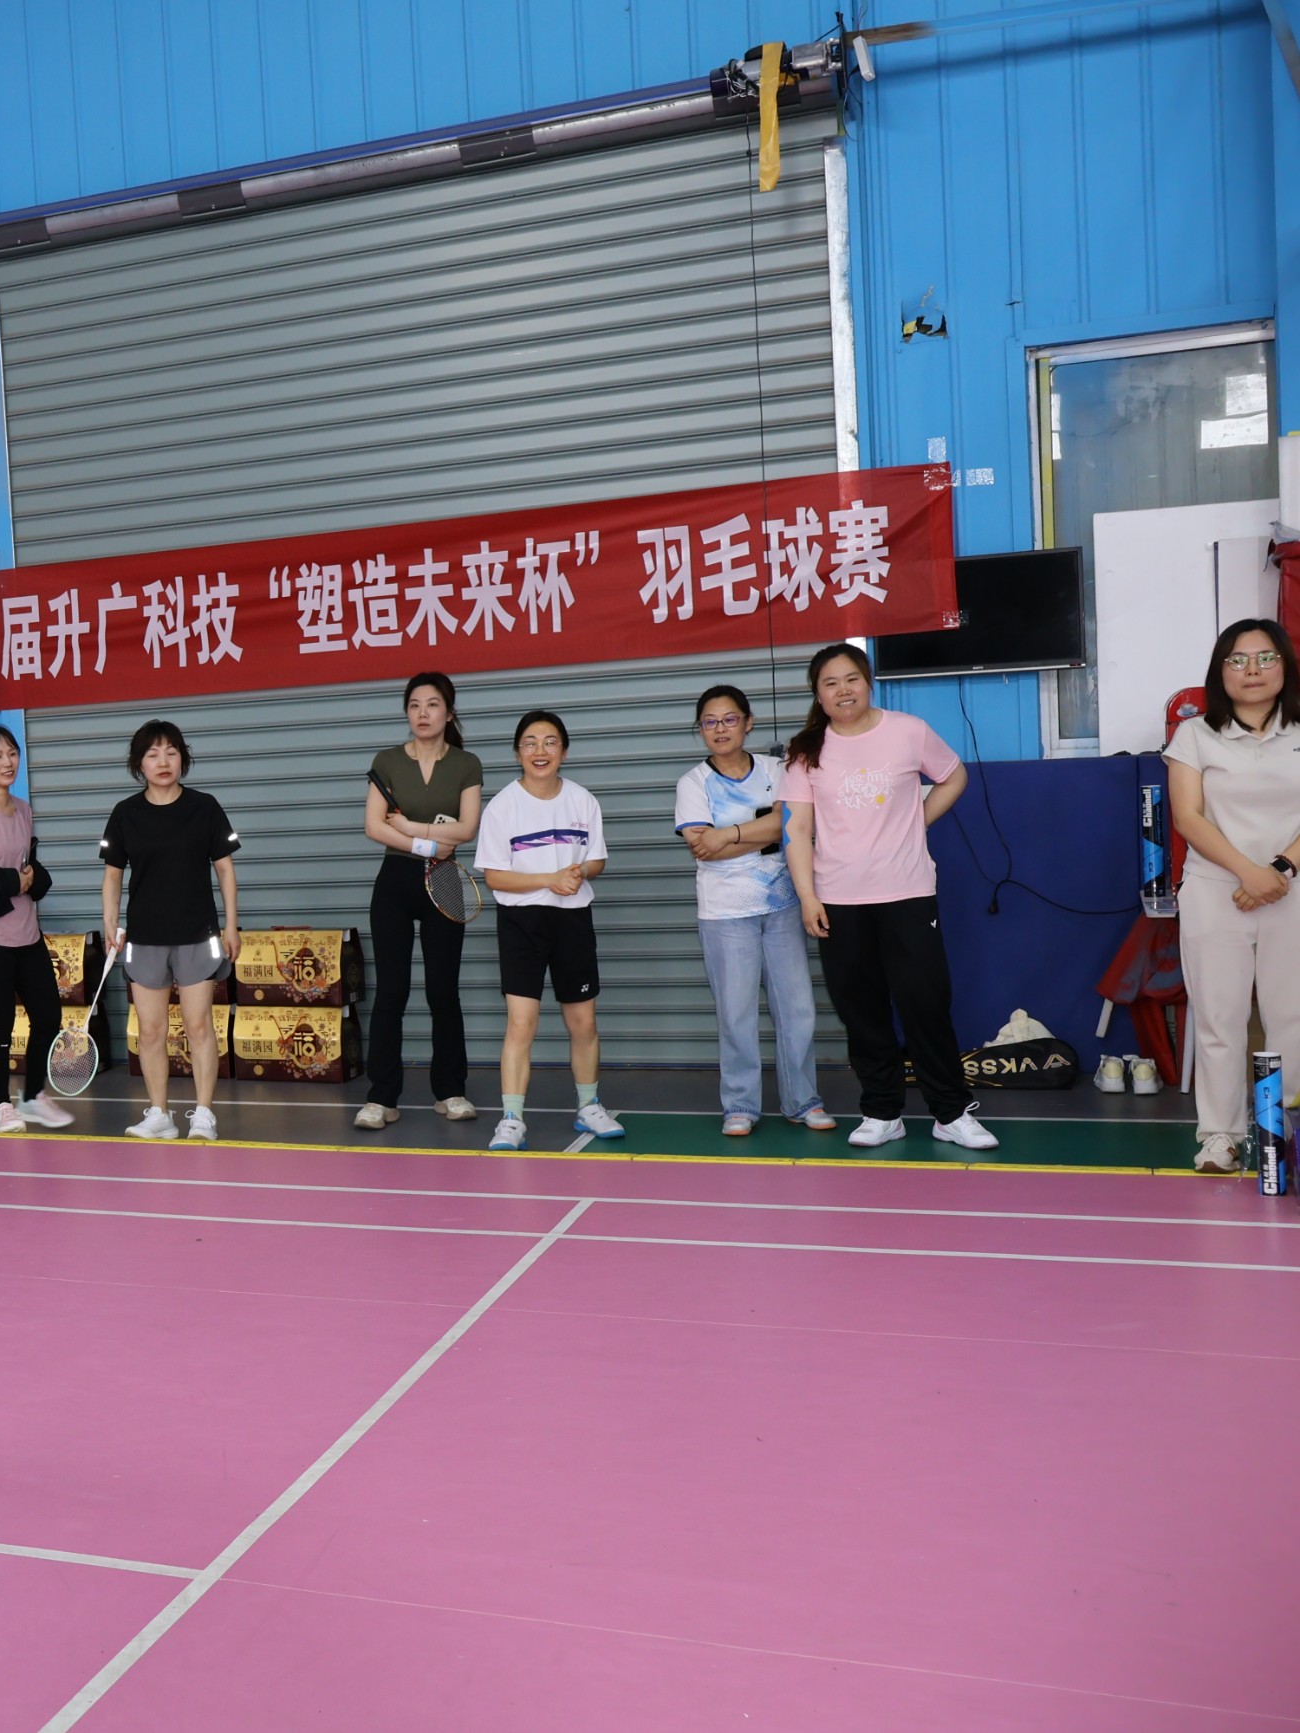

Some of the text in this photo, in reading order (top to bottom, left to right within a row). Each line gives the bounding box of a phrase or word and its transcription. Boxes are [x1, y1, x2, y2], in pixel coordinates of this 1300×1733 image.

[268, 531, 601, 655] “塑造未来杯”
[636, 500, 893, 624] 羽毛球赛
[243, 965, 274, 978] 福满园
[242, 1040, 273, 1053] 福满园
